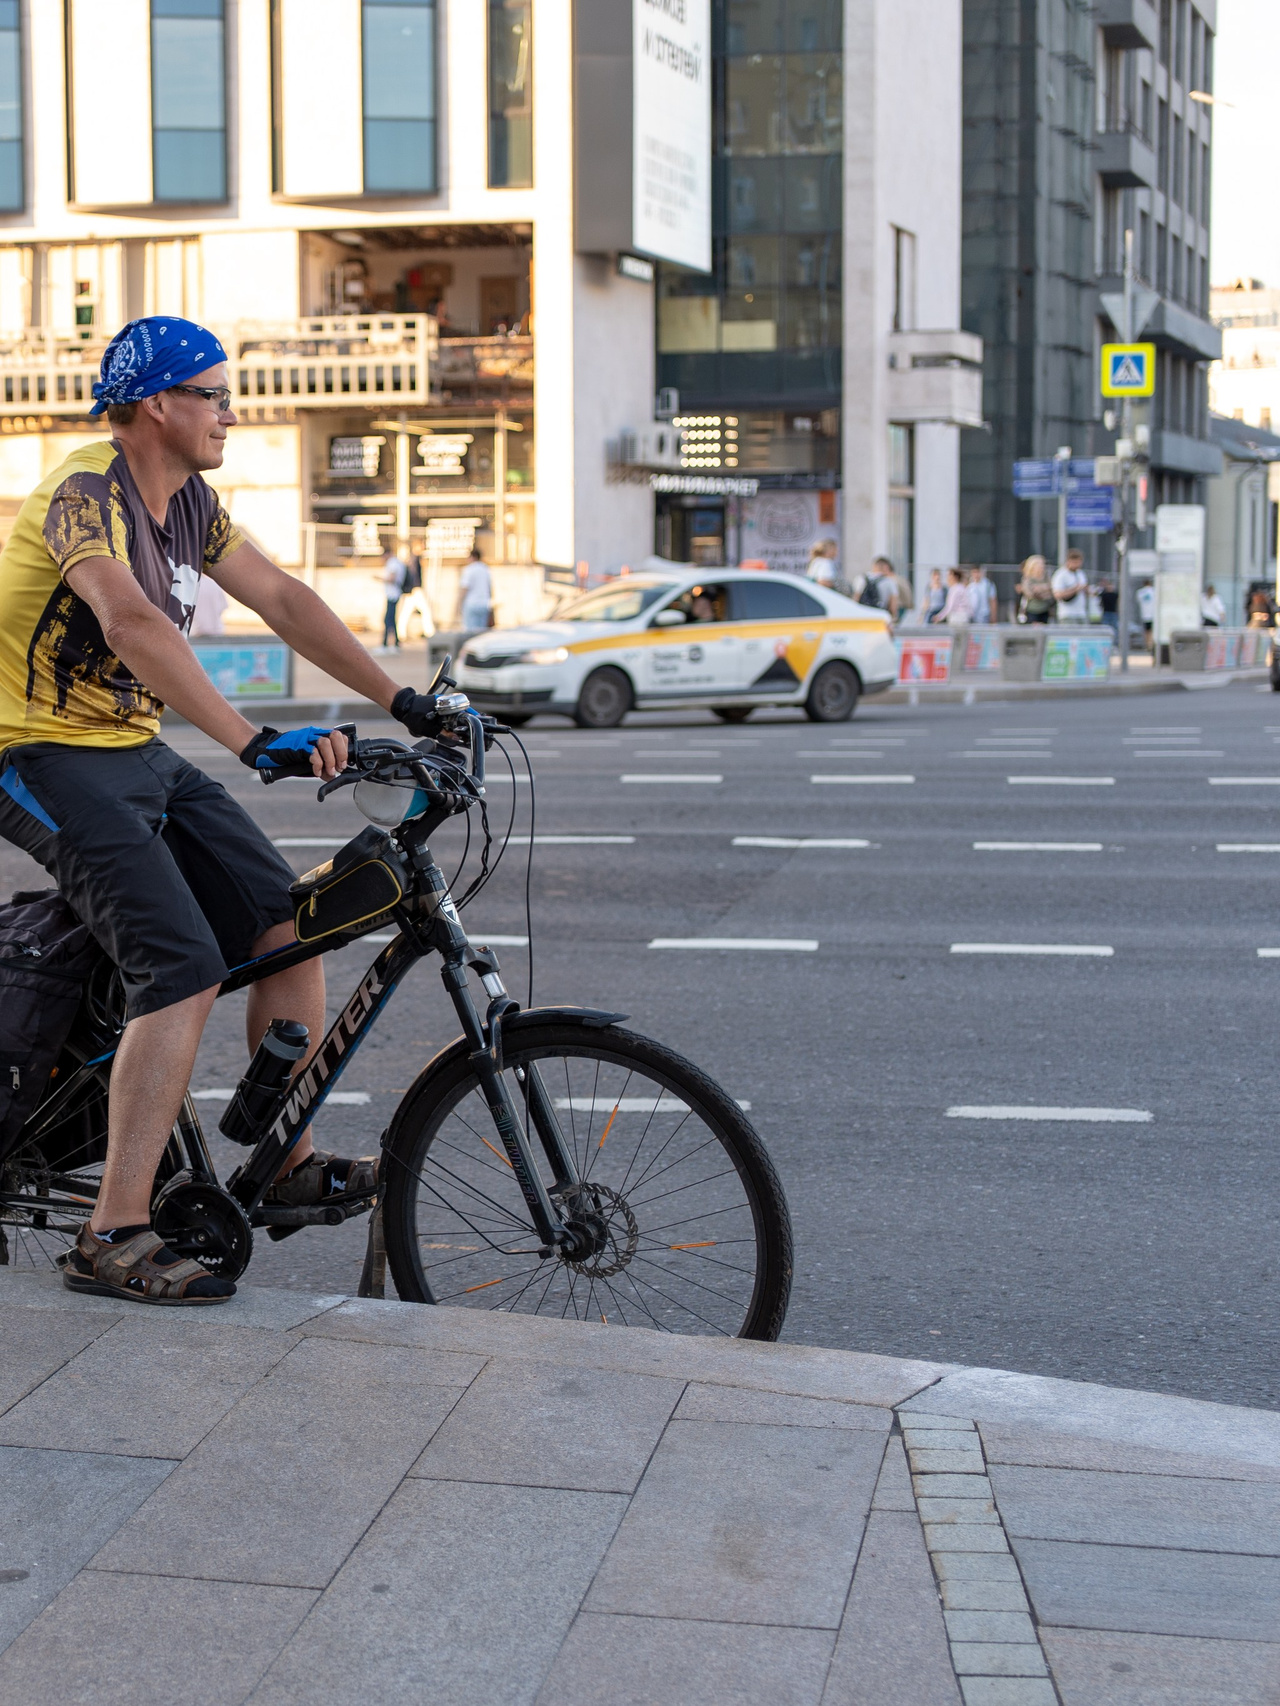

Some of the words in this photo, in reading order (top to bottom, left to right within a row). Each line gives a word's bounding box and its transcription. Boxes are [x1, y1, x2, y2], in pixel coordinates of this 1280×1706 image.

[352, 909, 393, 931] TWITTE
[269, 966, 385, 1147] TWITTER
[502, 1133, 539, 1205] TWITTER
